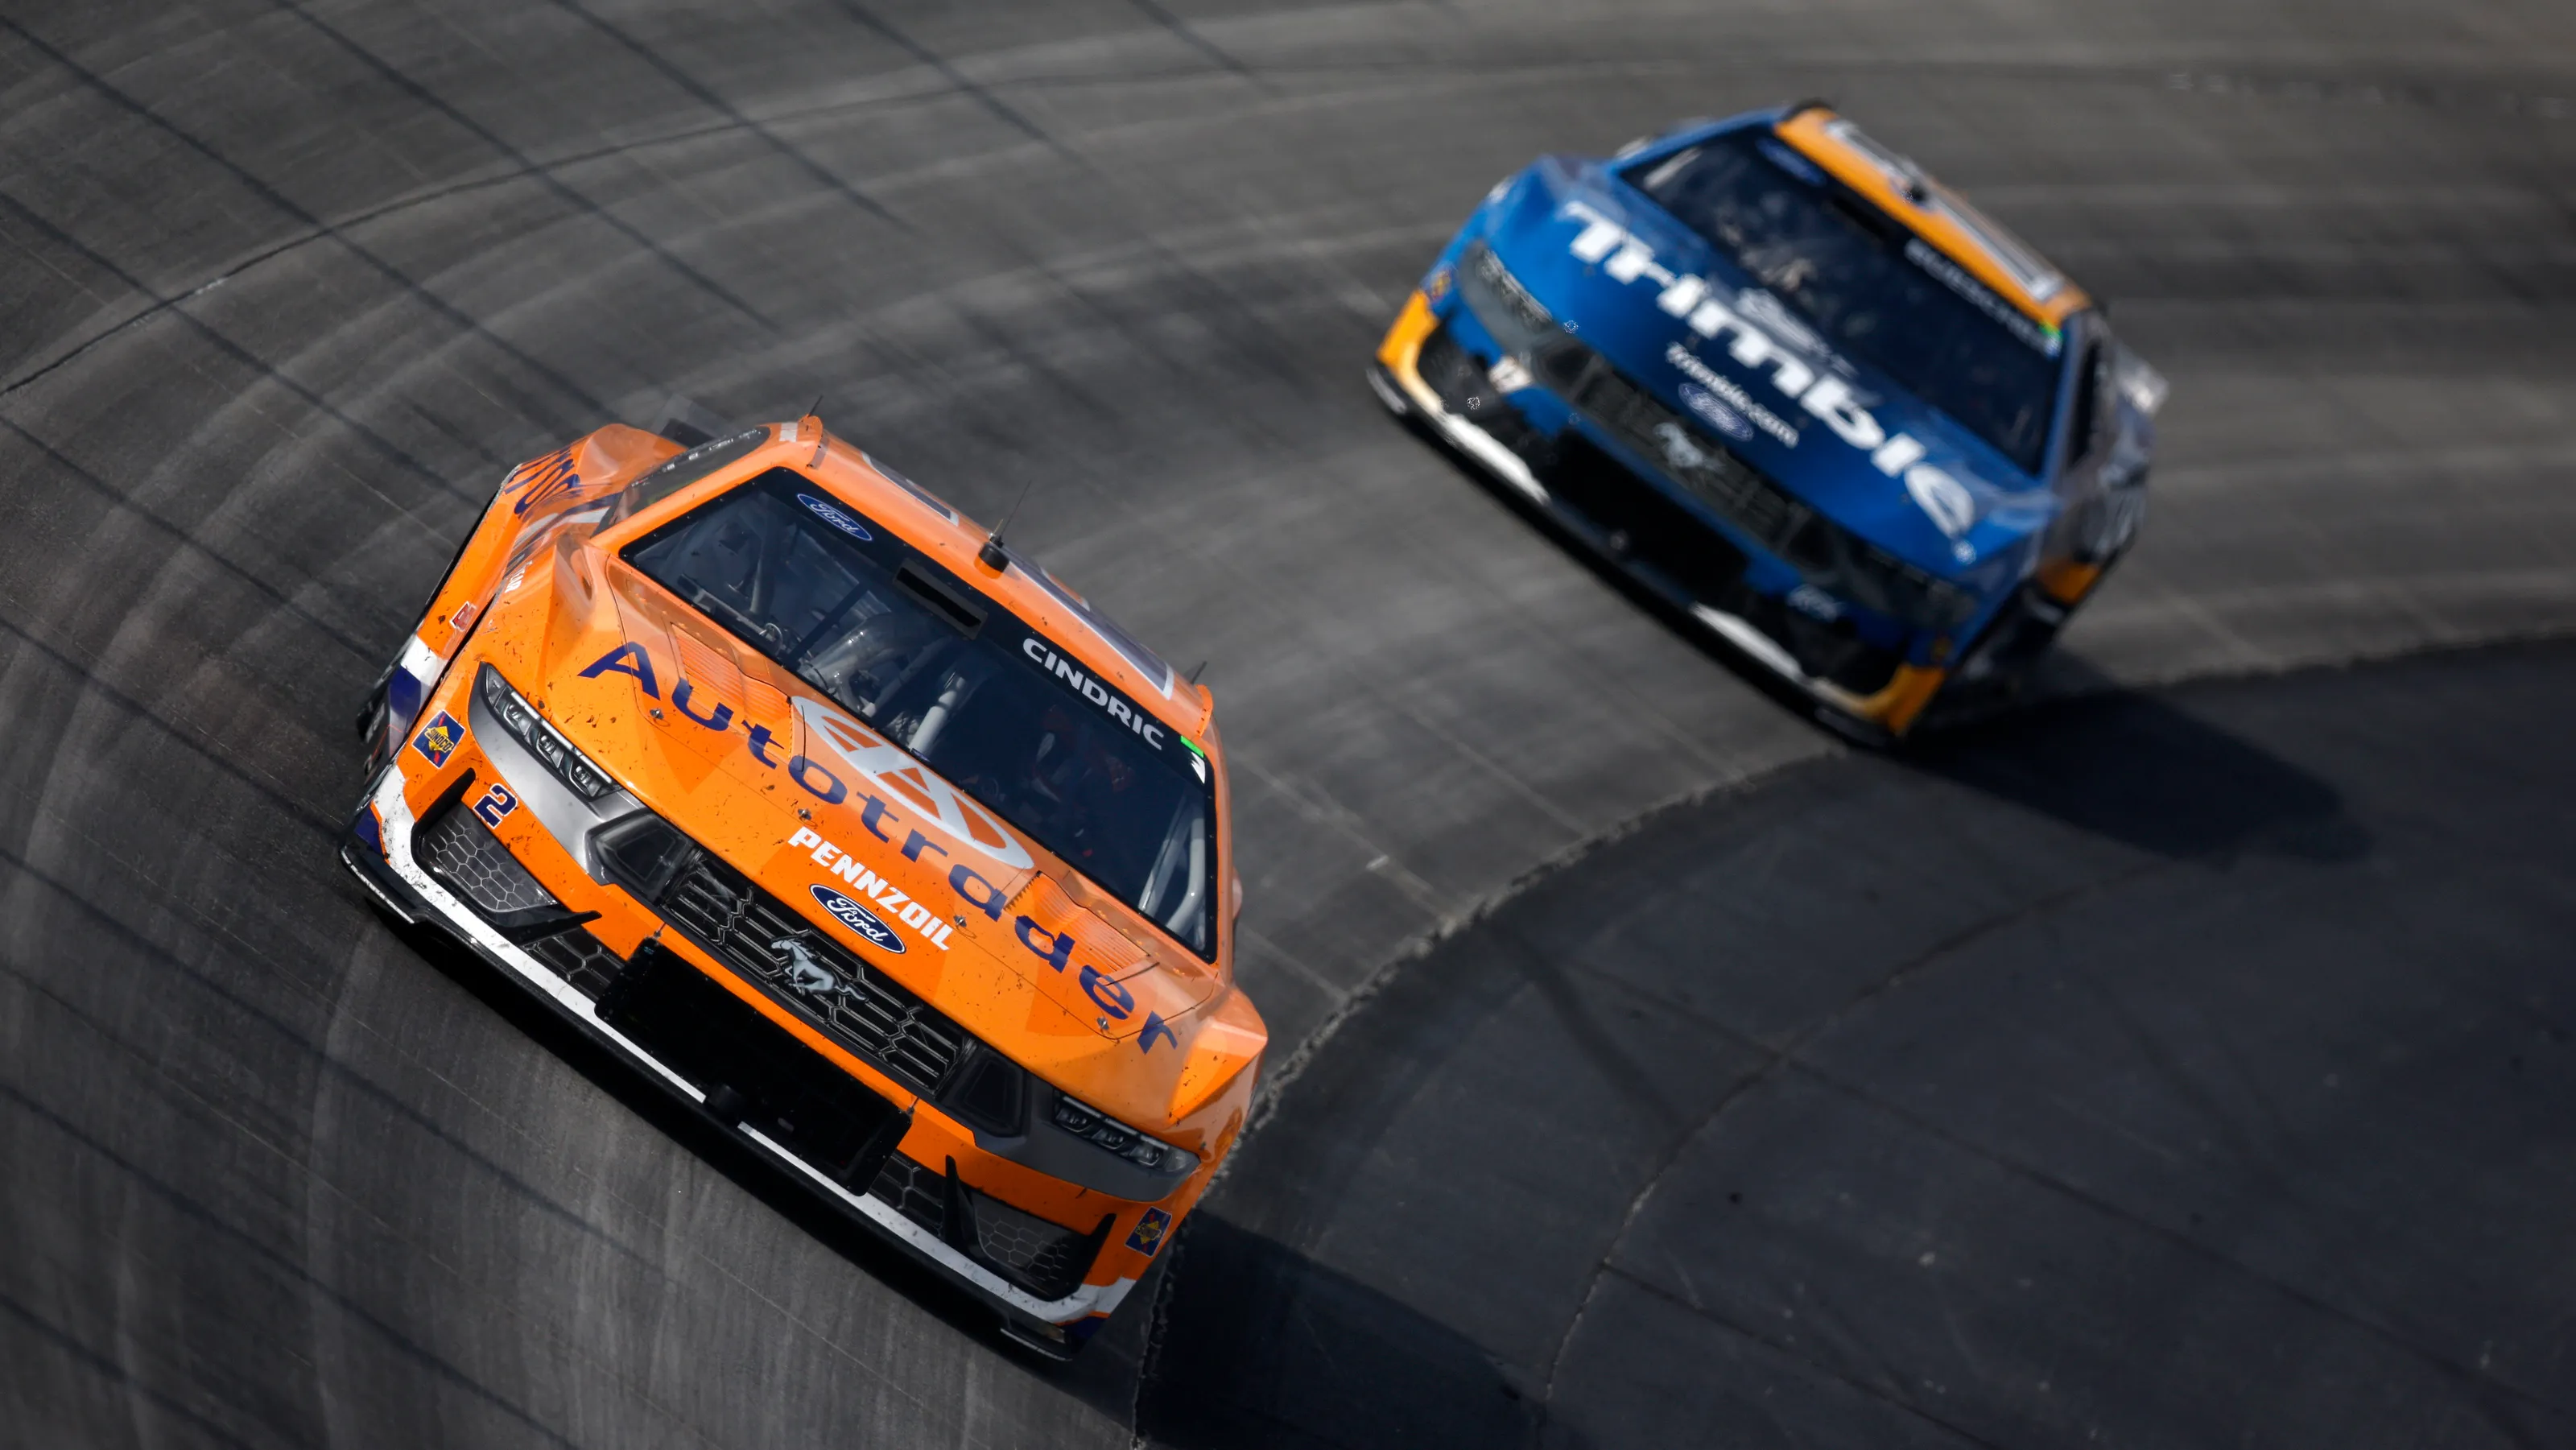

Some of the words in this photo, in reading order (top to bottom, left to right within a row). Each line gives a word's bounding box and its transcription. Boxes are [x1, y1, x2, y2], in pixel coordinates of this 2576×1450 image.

[1563, 201, 1975, 538] Trimble
[430, 727, 453, 752] SUNOCO
[1022, 638, 1165, 750] CINDRIC
[473, 783, 518, 829] 2
[577, 641, 1179, 1054] Autotrader
[789, 826, 953, 951] PENNZOIL
